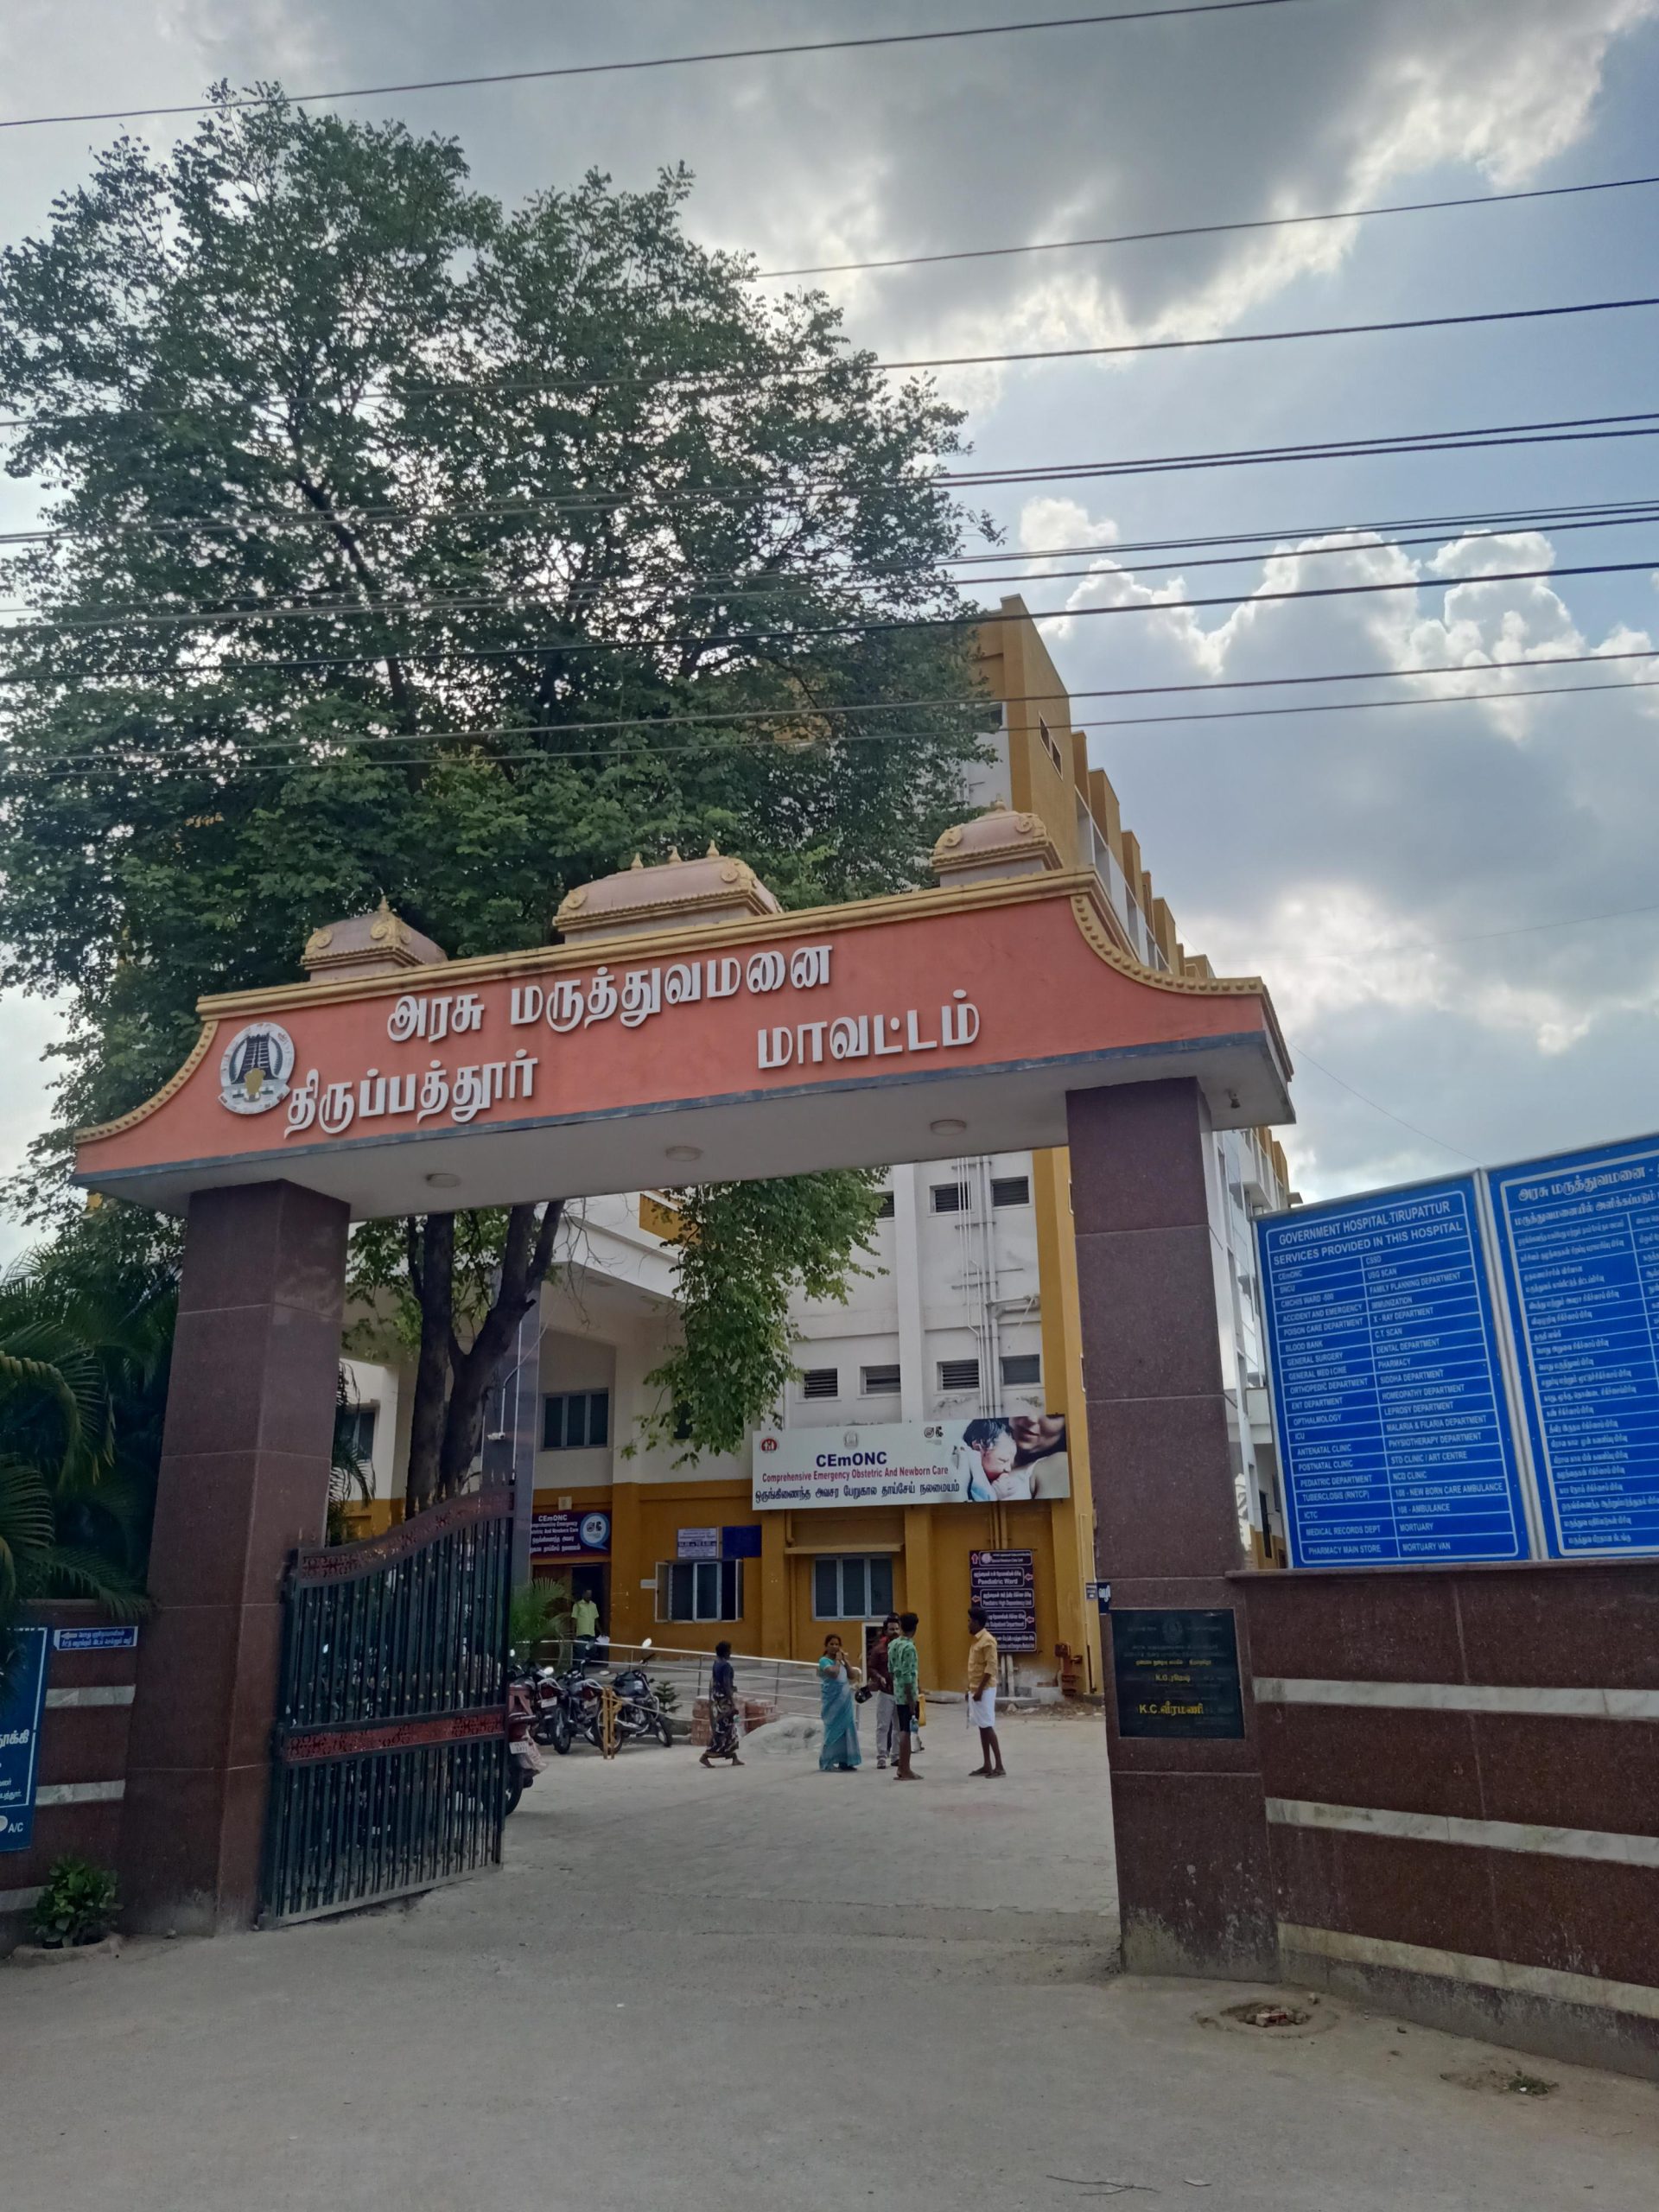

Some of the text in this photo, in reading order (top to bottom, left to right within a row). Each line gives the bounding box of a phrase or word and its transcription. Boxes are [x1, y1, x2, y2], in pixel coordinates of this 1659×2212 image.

[387, 944, 832, 1042] அரசு மருத்துவமனை
[757, 988, 981, 1070] மாவட்டம்
[284, 1049, 538, 1140] திருப்பத்தூர்
[1518, 1186, 1549, 1201] அரசு
[1279, 1223, 1340, 1245] GOVERNMENT
[1274, 1221, 1463, 1266] SERVICES PROVIDED IN THIS HOSPITAL
[1370, 1283, 1389, 1294] FAMILY
[1421, 1272, 1460, 1287] DEPARTMENT
[1282, 1304, 1363, 1322] ACCIDENT AND EMERGENCY
[1394, 1306, 1433, 1319] DEPARTMENT
[1306, 1323, 1323, 1334] CARE
[1323, 1318, 1363, 1332] DEPARTMENT
[1386, 1328, 1402, 1337] SCAN
[1285, 1339, 1324, 1352] BLOOD BANK
[1376, 1338, 1440, 1355] DENTAL DEPARTMENT
[1287, 1351, 1343, 1366] GENERAL SURGERY
[1377, 1357, 1411, 1370] PHARMACY
[1288, 1370, 1316, 1381] GENERAL
[1404, 1370, 1444, 1382] DEPARTMENT
[1328, 1377, 1368, 1390] DEPARTMENT
[1424, 1383, 1465, 1396] DEPARTMENT
[1304, 1396, 1343, 1408] DEPARTMENT
[1384, 1401, 1453, 1415] LEPROSY DEPARTMENT
[1386, 1421, 1415, 1432] MALARIA
[1445, 1414, 1486, 1427] DEPARTMENT
[1440, 1432, 1482, 1444] DEPARTMENT
[1297, 1444, 1352, 1456] ANTENATAL CLINIC
[816, 1451, 887, 1468] CEmONC
[1404, 1454, 1424, 1464] CLINIC
[1428, 1452, 1441, 1461] ART
[1441, 1451, 1468, 1460] CENTRE
[1298, 1459, 1353, 1471] POSTNATAL CLINIC
[762, 1465, 949, 1484] Comprehensive Emergency Obstetric And Newborn Care
[1300, 1474, 1372, 1487] PEDIATRIC DEPARTMENT
[1407, 1471, 1427, 1479] CLINIC
[1409, 1487, 1425, 1497] NEW
[1425, 1486, 1444, 1496] BORN
[1444, 1484, 1462, 1494] CARE
[1462, 1482, 1503, 1493] AMBULANCE
[1411, 1503, 1451, 1513] AMBULANCE
[1306, 1524, 1381, 1536] MEDICAL RECORDS DEPT
[1399, 1522, 1433, 1532] MORTUARY
[1308, 1544, 1382, 1555] PHARMACY MAIN STORE
[1402, 1541, 1451, 1552] MORTUARY VAN
[8, 1822, 23, 1833] A/C
